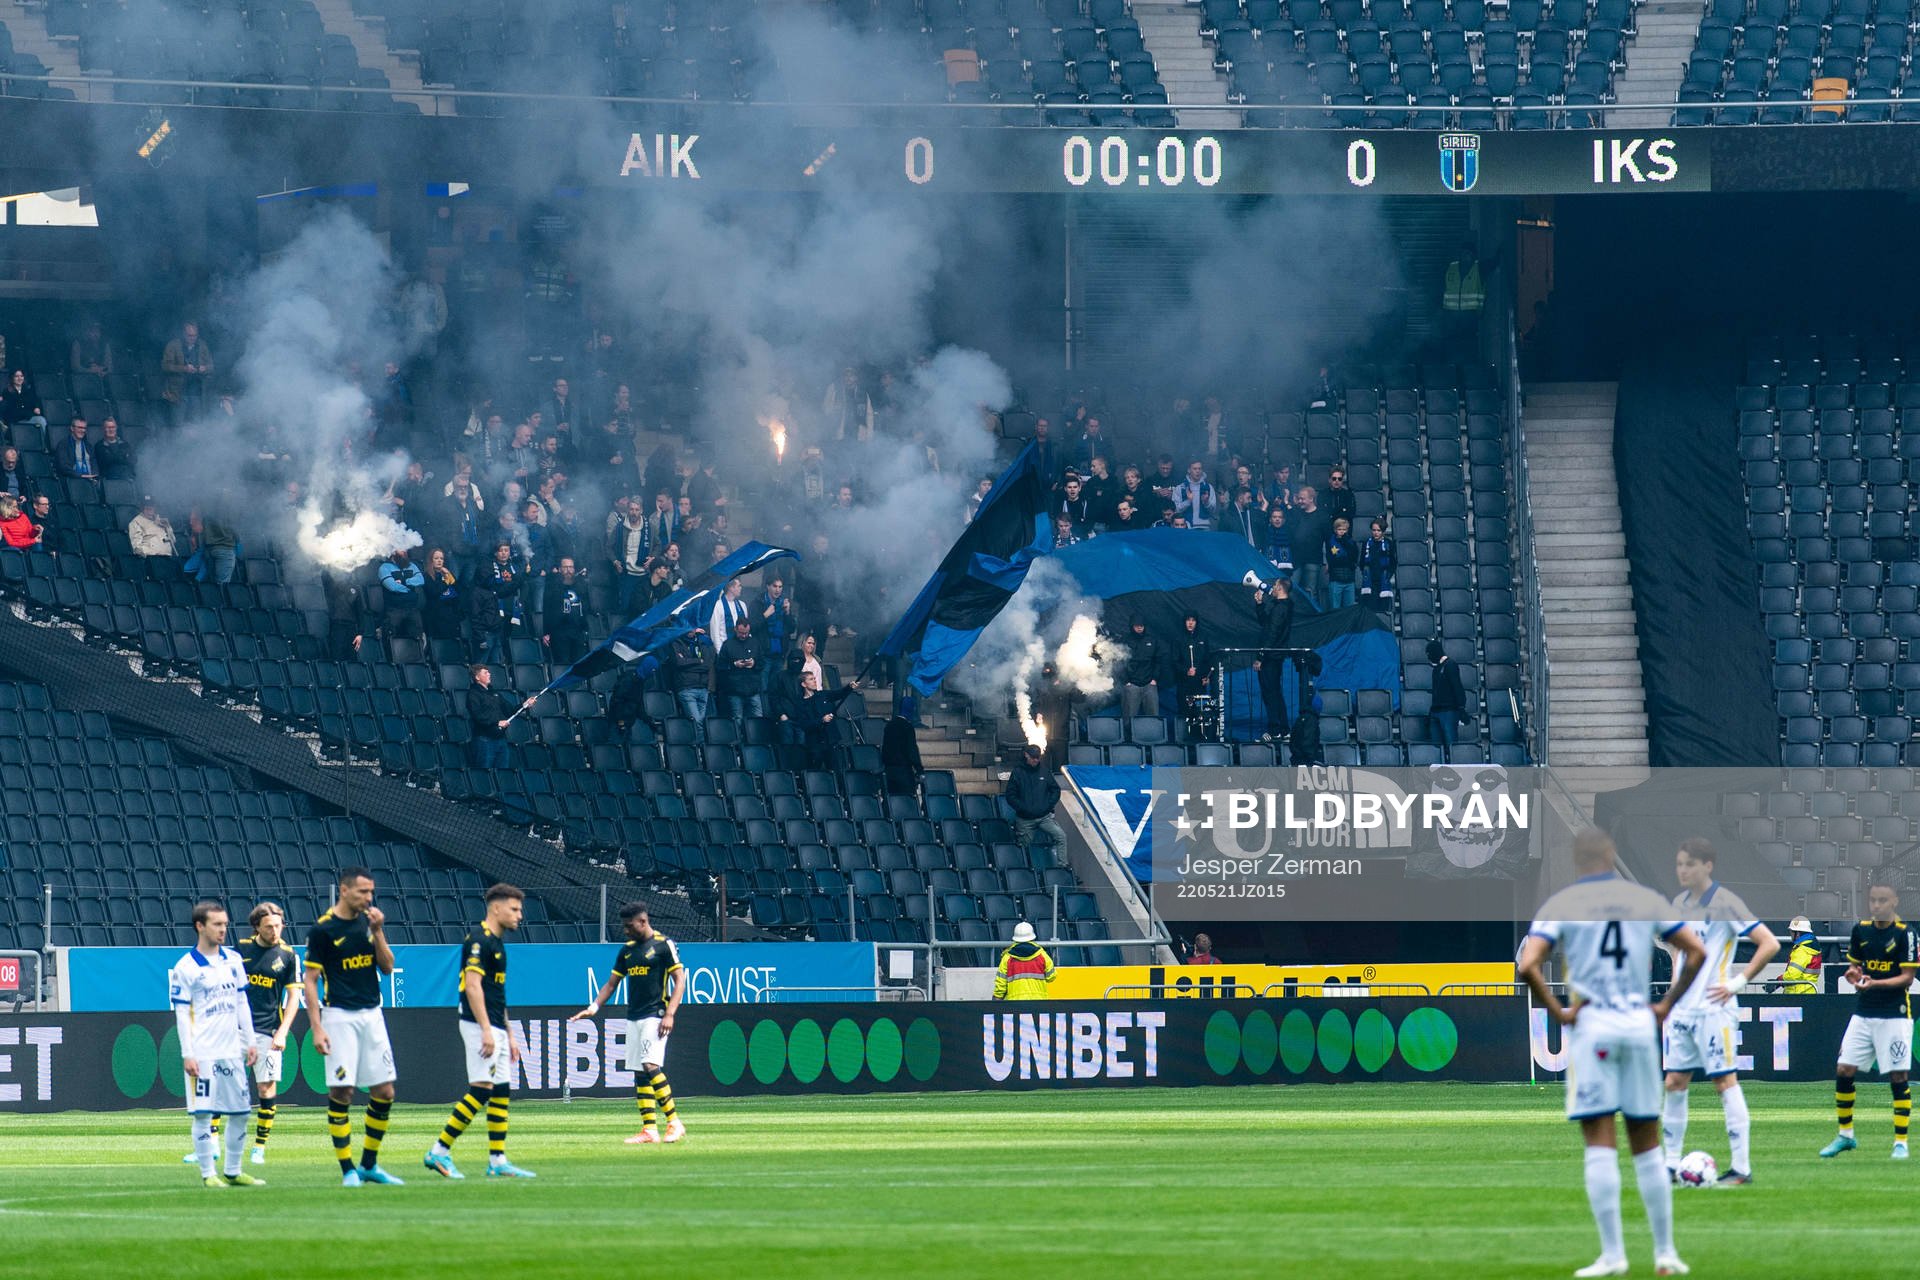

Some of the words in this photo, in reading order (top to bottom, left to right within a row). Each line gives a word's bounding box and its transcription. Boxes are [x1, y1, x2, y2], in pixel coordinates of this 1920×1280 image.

[620, 134, 701, 178] AIK
[905, 137, 934, 185] 0
[1063, 136, 1222, 186] 00:00
[1347, 140, 1376, 186] 0
[1593, 139, 1678, 183] IKS
[1443, 136, 1476, 148] SIRIUS
[1297, 765, 1349, 791] ACM
[1082, 787, 1168, 859] V
[1600, 919, 1628, 969] 4
[1866, 960, 1893, 972] otar
[1, 965, 17, 982] 08
[588, 966, 776, 1004] MMQVIST
[509, 1018, 635, 1090] NIBE
[983, 1011, 1166, 1082] UNIBET
